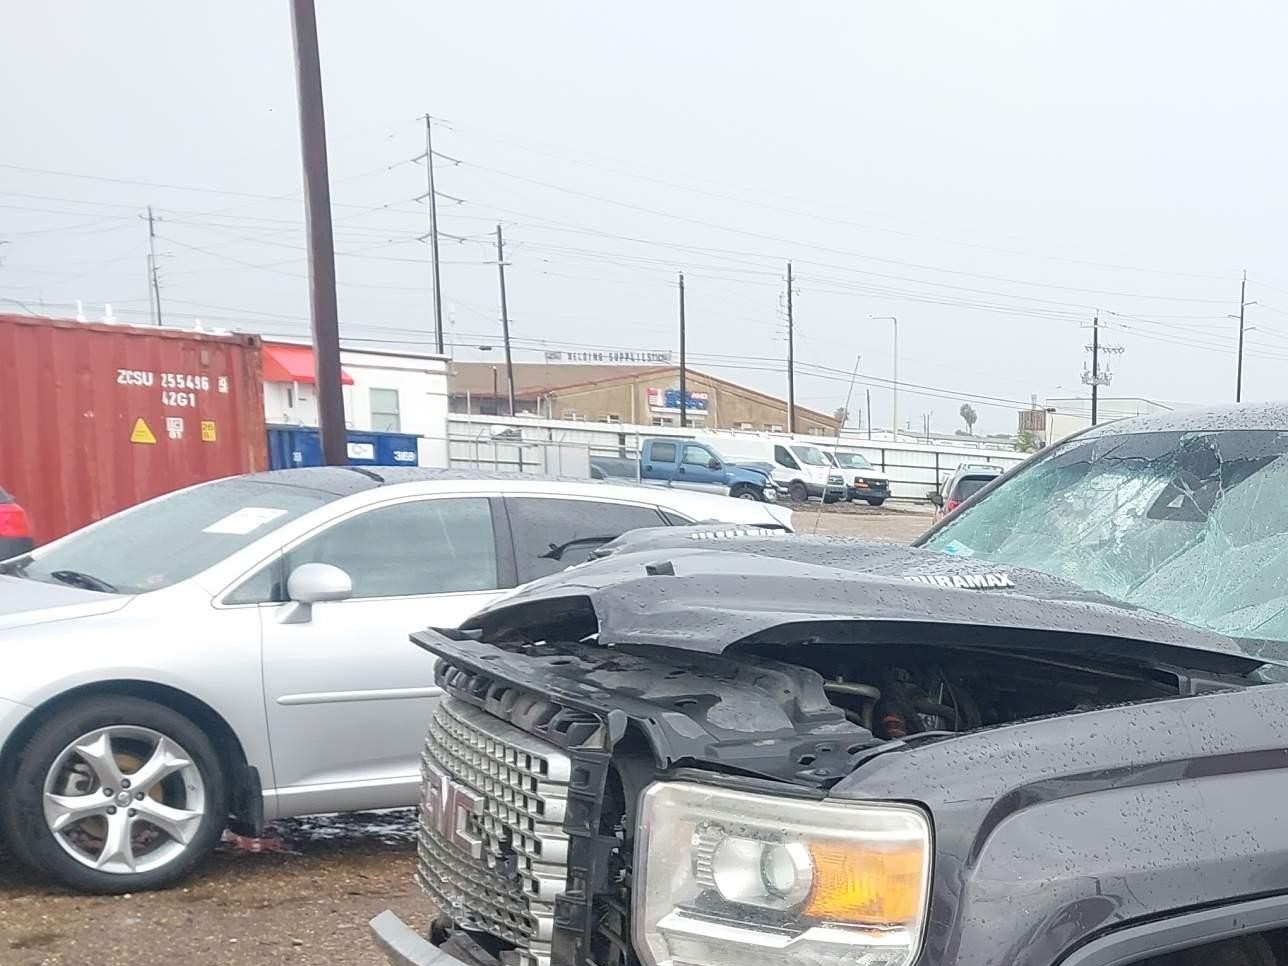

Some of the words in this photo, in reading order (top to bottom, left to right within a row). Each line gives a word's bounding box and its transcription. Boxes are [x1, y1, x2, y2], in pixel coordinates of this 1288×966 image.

[116, 369, 154, 387] ZCSU
[160, 373, 210, 392] 255496
[162, 391, 196, 408] 42G1
